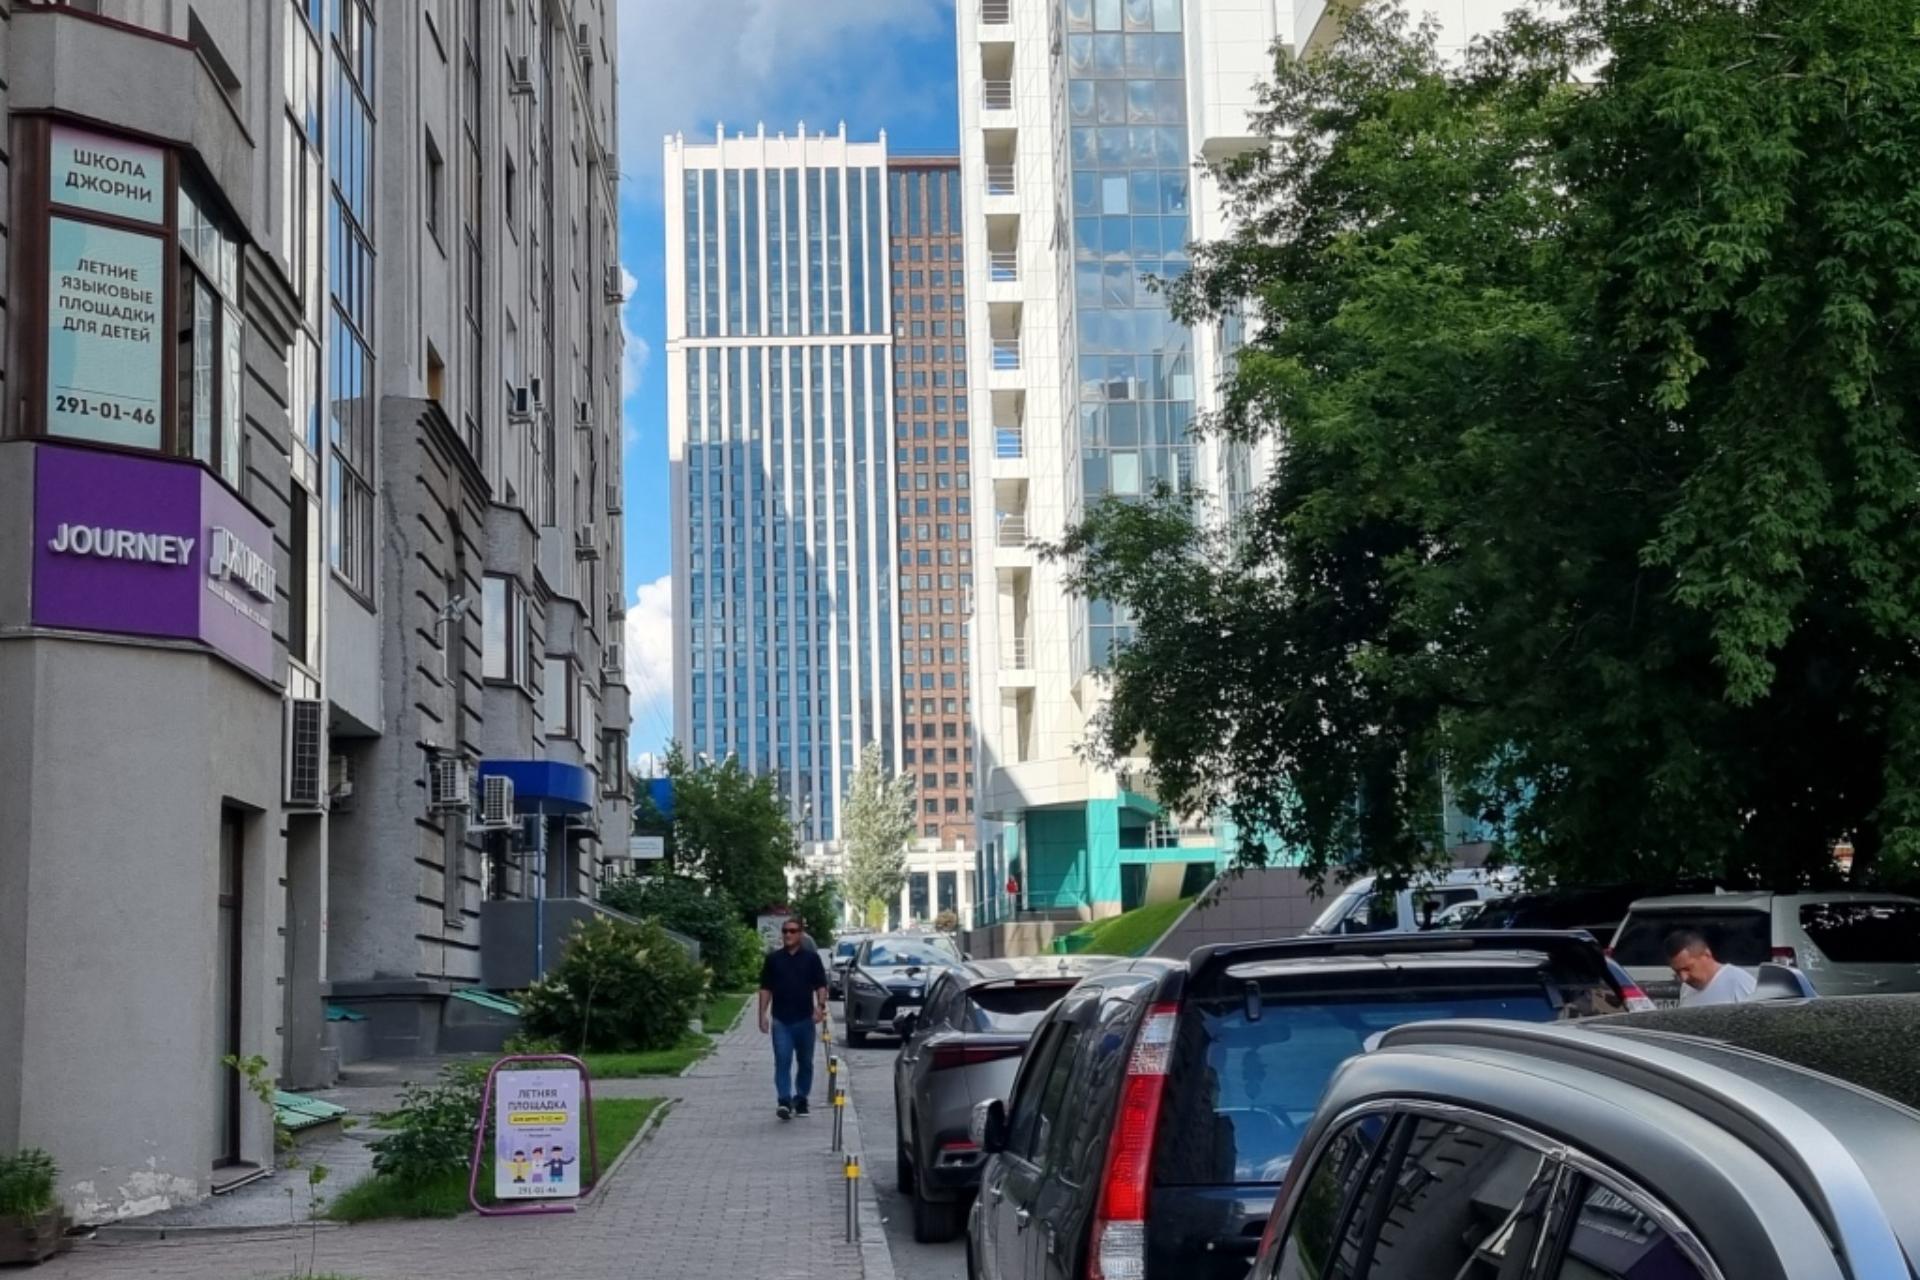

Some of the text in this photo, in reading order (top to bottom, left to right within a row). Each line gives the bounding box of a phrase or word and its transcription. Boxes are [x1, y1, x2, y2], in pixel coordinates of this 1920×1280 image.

[73, 149, 146, 179] ШКОЛА
[65, 171, 152, 202] ДЖОРНИ
[77, 258, 138, 281] ЛЕТНИЕ
[61, 276, 153, 304] ЯЗЫКОВЫЕ
[59, 296, 155, 325] ПЛОЩАДКИ
[63, 316, 151, 343] ДЛЯ ДЕТЕЙ
[55, 395, 156, 425] 291-01-46
[49, 523, 195, 565] JOURNEY
[508, 1102, 567, 1111] ПЛОЩАДКА
[518, 1089, 558, 1099] ЛЕТНЯЯ
